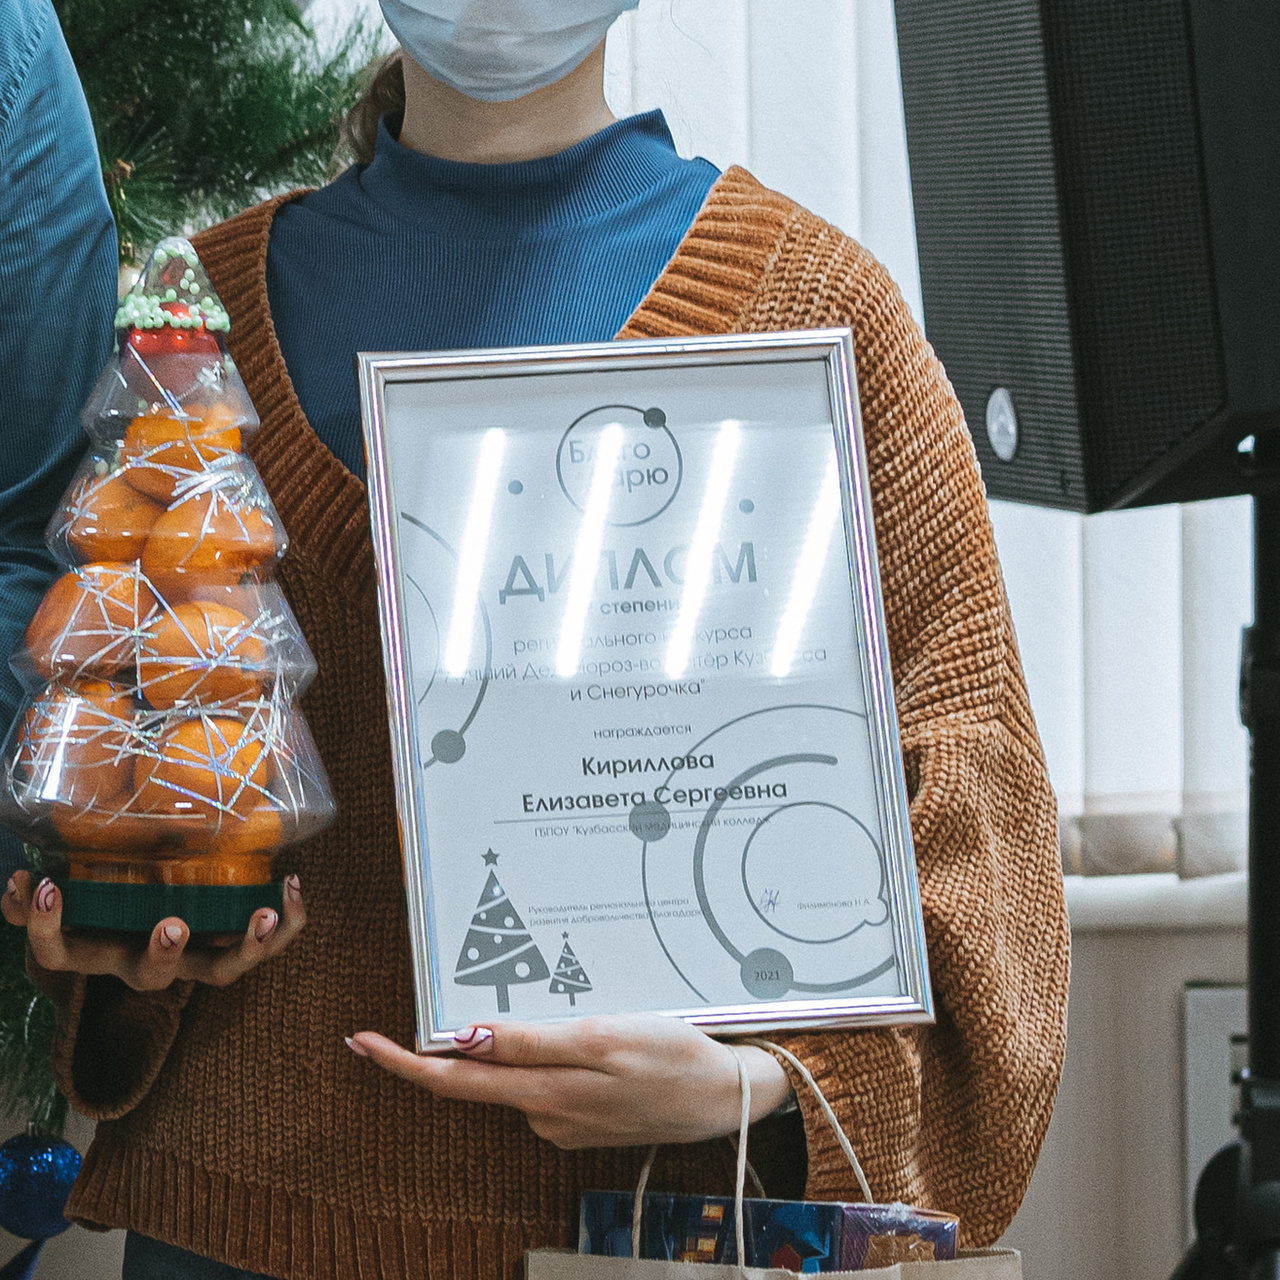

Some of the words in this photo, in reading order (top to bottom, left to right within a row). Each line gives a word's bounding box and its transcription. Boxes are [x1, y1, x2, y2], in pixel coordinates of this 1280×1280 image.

[570, 688, 582, 702] и
[586, 678, 705, 702] Снегурочка"
[593, 723, 692, 740] награждается
[581, 753, 715, 778] Кириллова
[522, 790, 646, 813] Елизавета
[653, 782, 788, 807] Сергеевна
[754, 969, 781, 981] 2021
